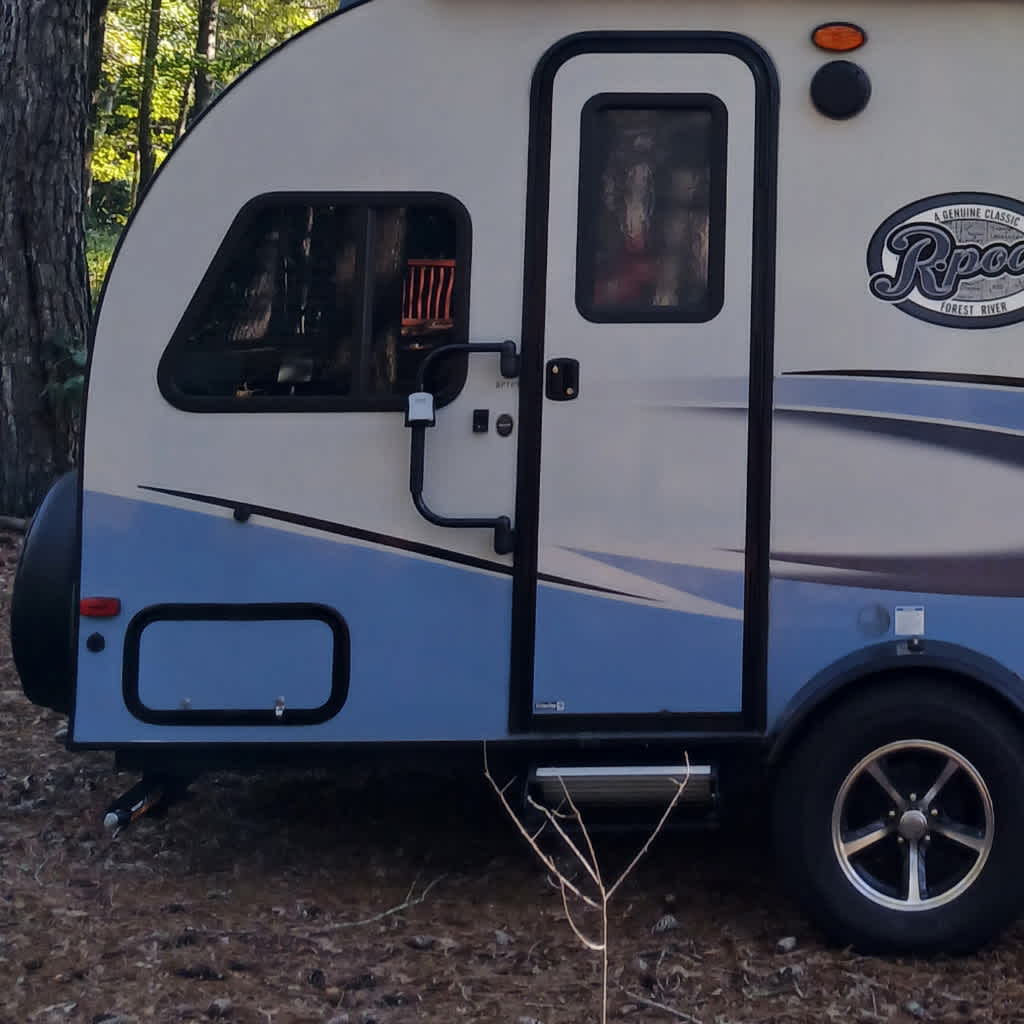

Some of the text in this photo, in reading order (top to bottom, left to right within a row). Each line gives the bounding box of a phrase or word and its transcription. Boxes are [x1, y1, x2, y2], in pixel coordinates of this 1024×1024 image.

[934, 207, 1021, 226] A GENUINE CLASSIC
[940, 301, 1008, 315] FOREST RIVER
